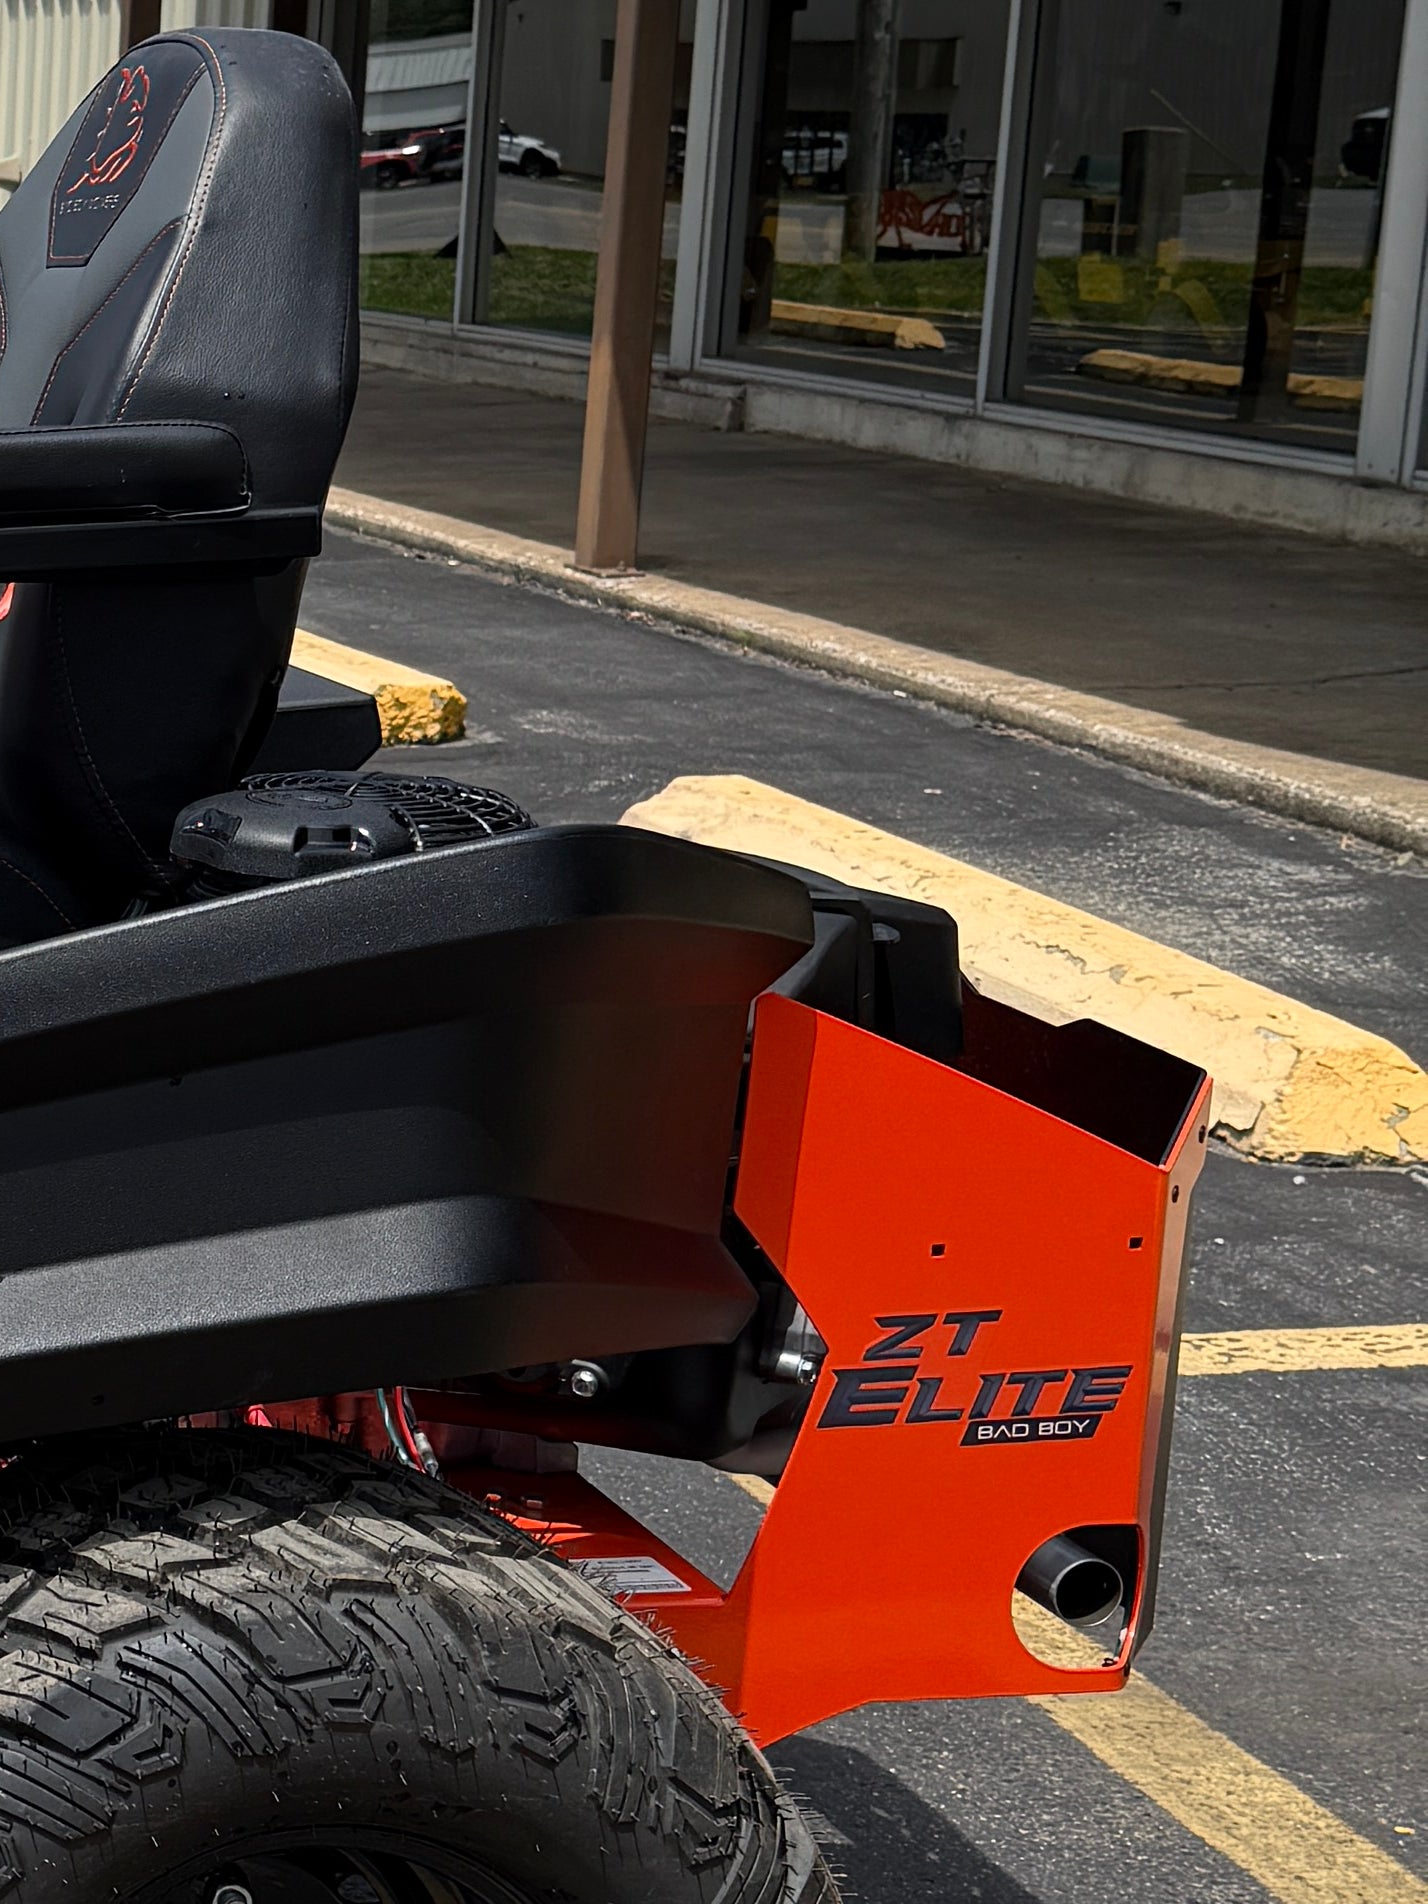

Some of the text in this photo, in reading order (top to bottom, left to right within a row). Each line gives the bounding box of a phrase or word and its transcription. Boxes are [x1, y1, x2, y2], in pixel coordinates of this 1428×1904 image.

[862, 1310, 1003, 1362] ZT
[817, 1365, 1133, 1429] ELITE
[977, 1419, 1090, 1441] BAD BOY
